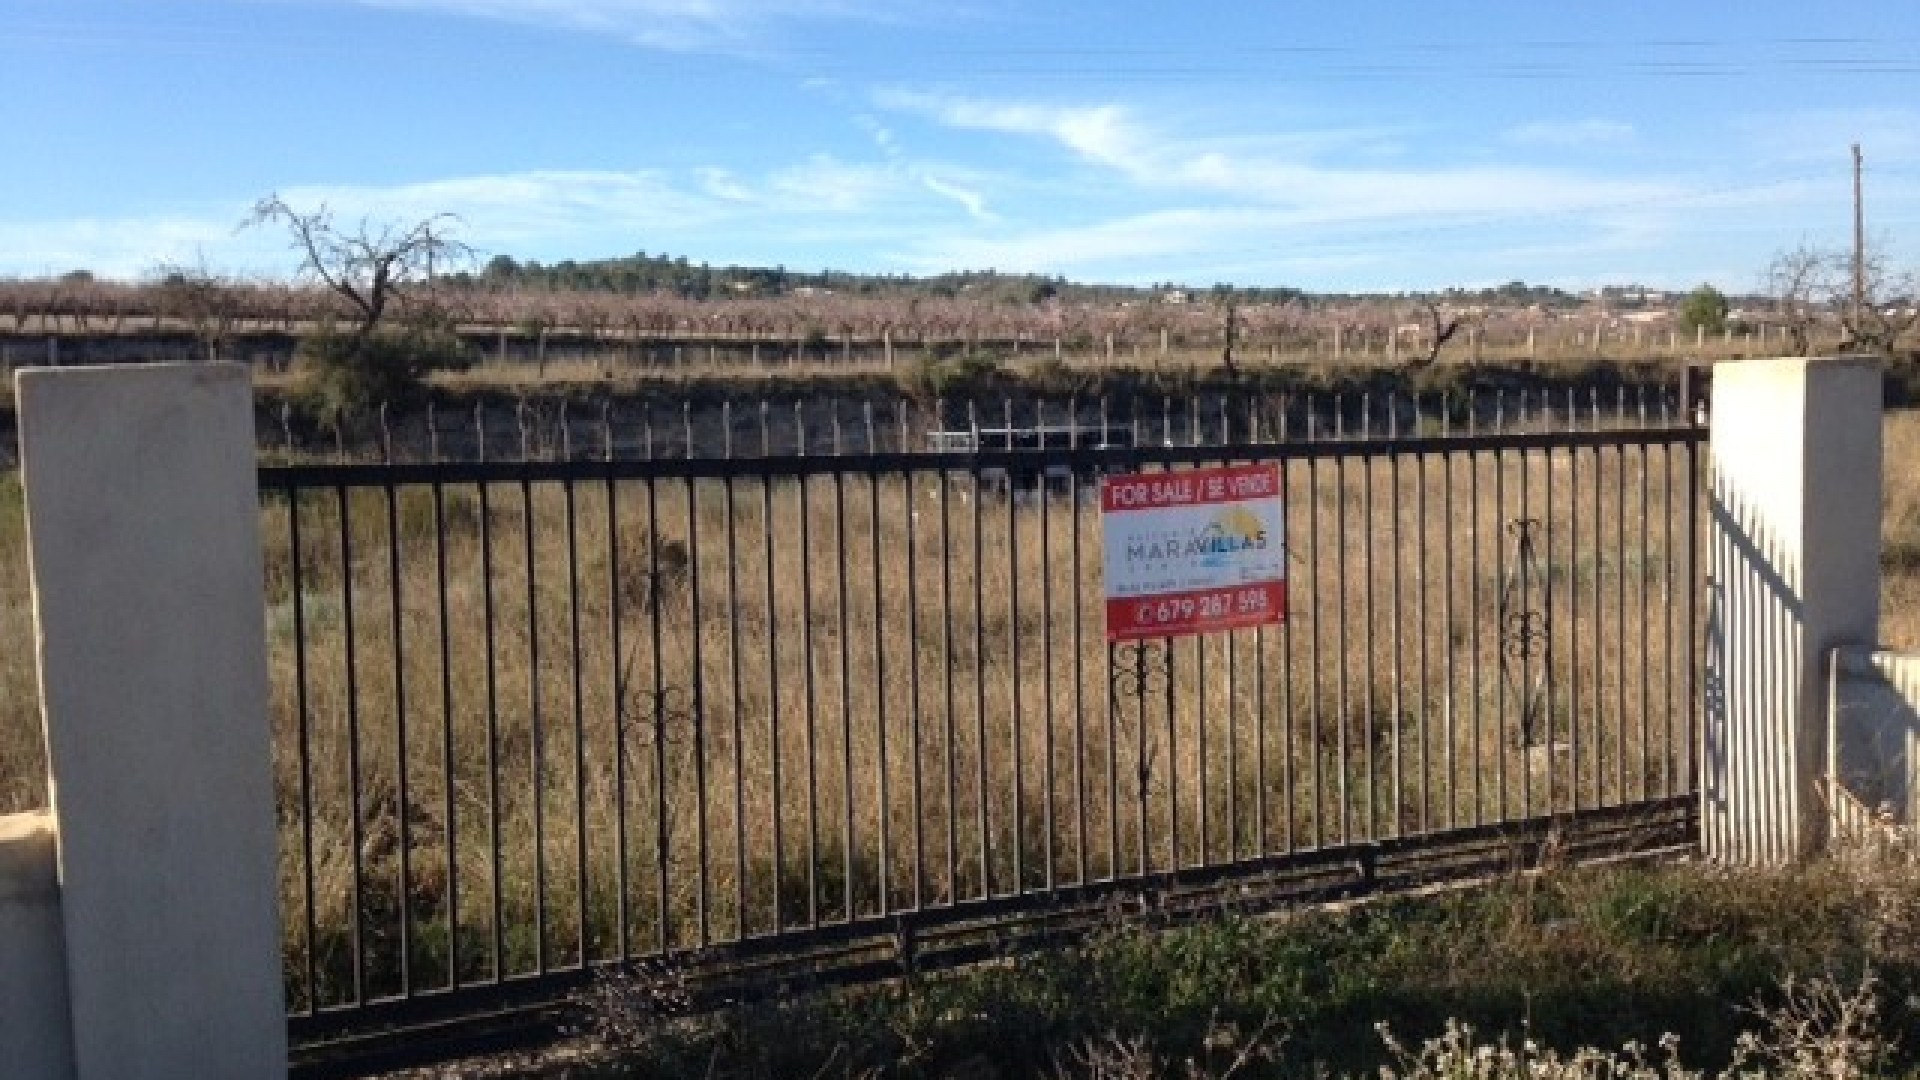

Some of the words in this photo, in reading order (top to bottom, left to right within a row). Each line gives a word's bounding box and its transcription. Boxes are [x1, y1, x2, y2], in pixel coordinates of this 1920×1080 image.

[1112, 482, 1147, 506] FOR
[1151, 479, 1192, 502] SALE
[1208, 476, 1225, 499] SE
[1227, 473, 1271, 496] VENDE
[1127, 530, 1267, 561] MARAVILLAS
[1157, 600, 1195, 622] 679
